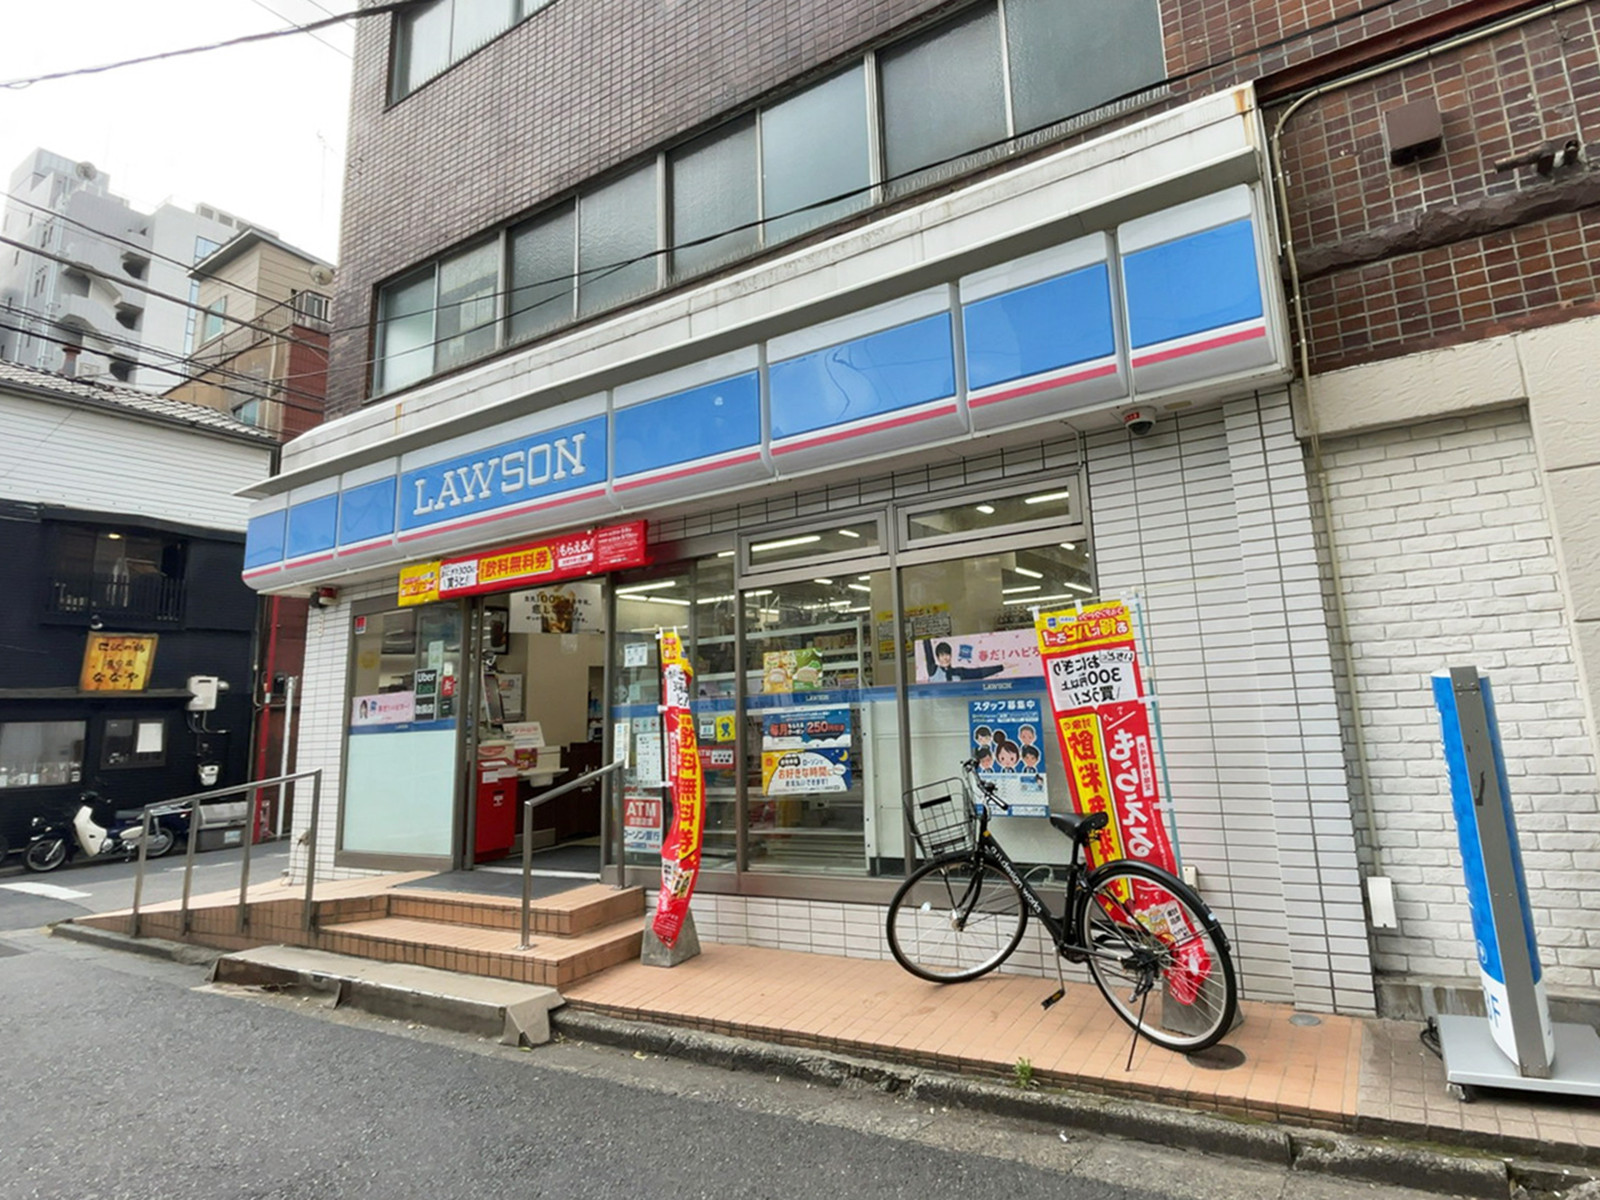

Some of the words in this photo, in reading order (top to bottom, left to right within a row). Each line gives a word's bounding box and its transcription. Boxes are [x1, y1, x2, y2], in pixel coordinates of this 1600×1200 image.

[413, 433, 586, 515] LAWSON
[486, 550, 548, 577] 飲料無料券
[417, 673, 436, 682] Uber
[973, 699, 1036, 712] スタッフ募集中
[627, 801, 656, 817] ATM
